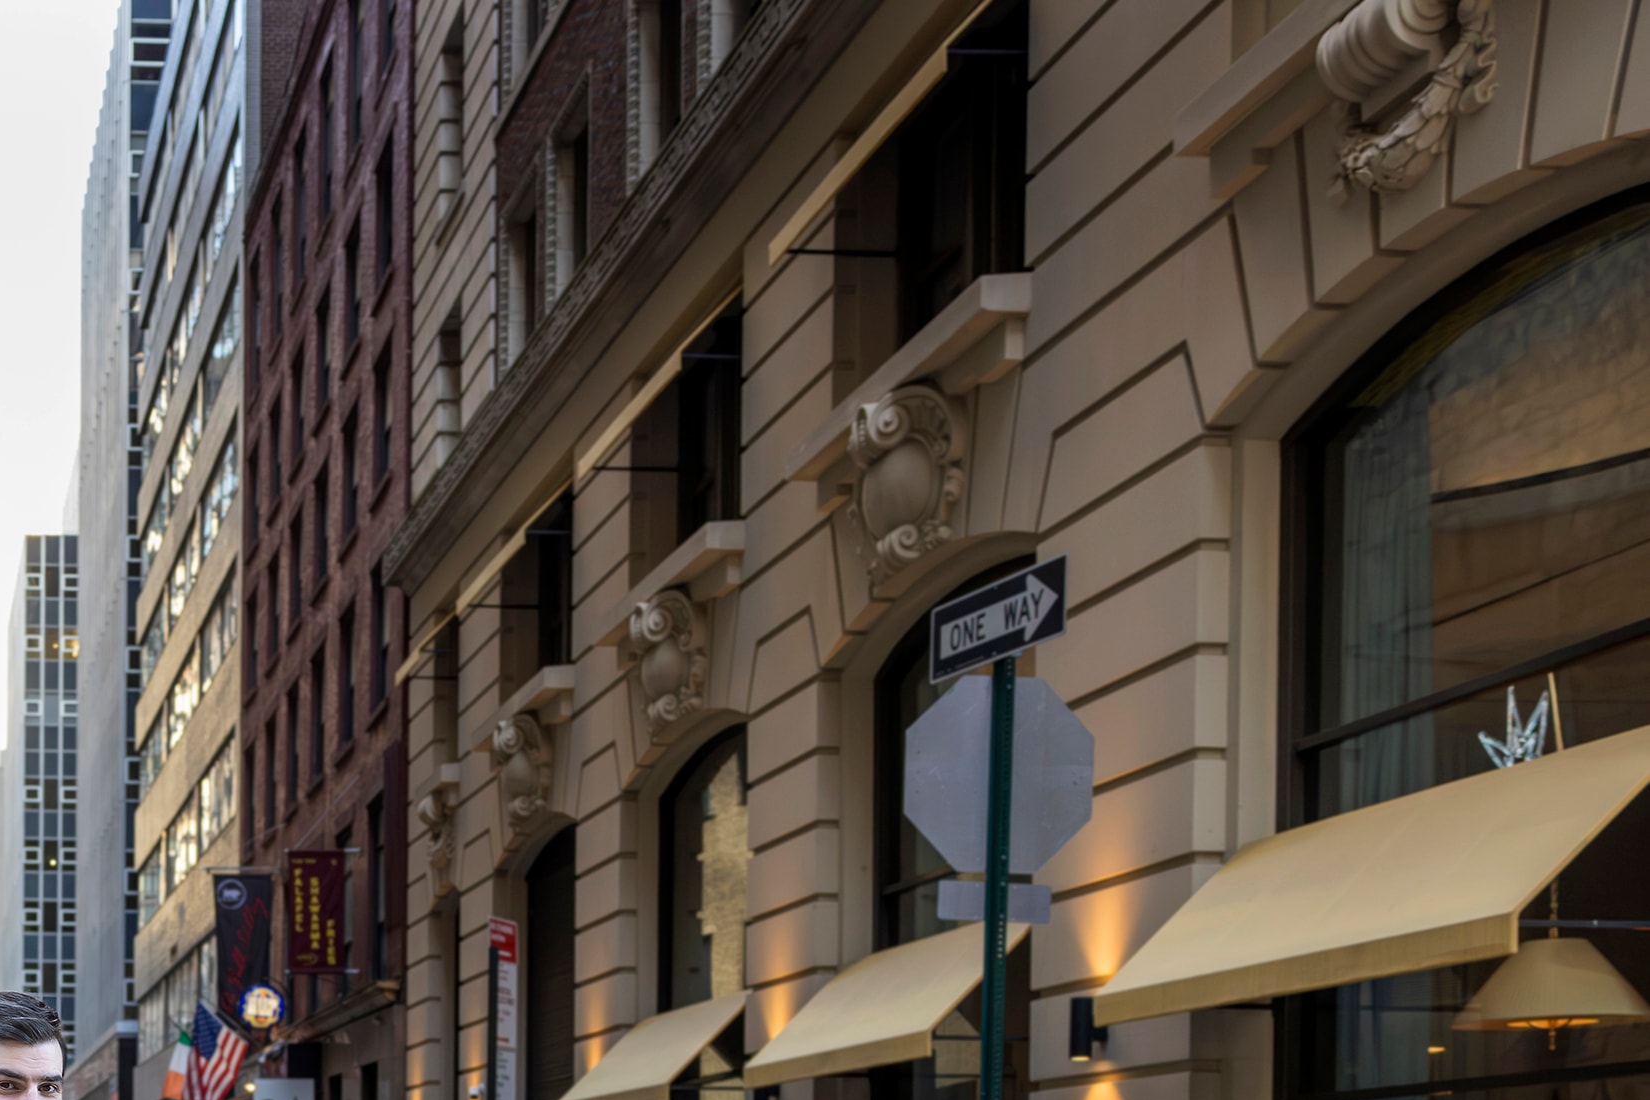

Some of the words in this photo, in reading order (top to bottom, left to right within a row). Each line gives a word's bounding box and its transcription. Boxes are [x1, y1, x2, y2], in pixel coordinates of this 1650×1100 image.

[950, 612, 987, 651] ONE
[1004, 588, 1045, 631] WAY
[293, 867, 304, 933] FALAFEL
[309, 876, 321, 950] SHAWARMA
[326, 918, 337, 966] FRIES
